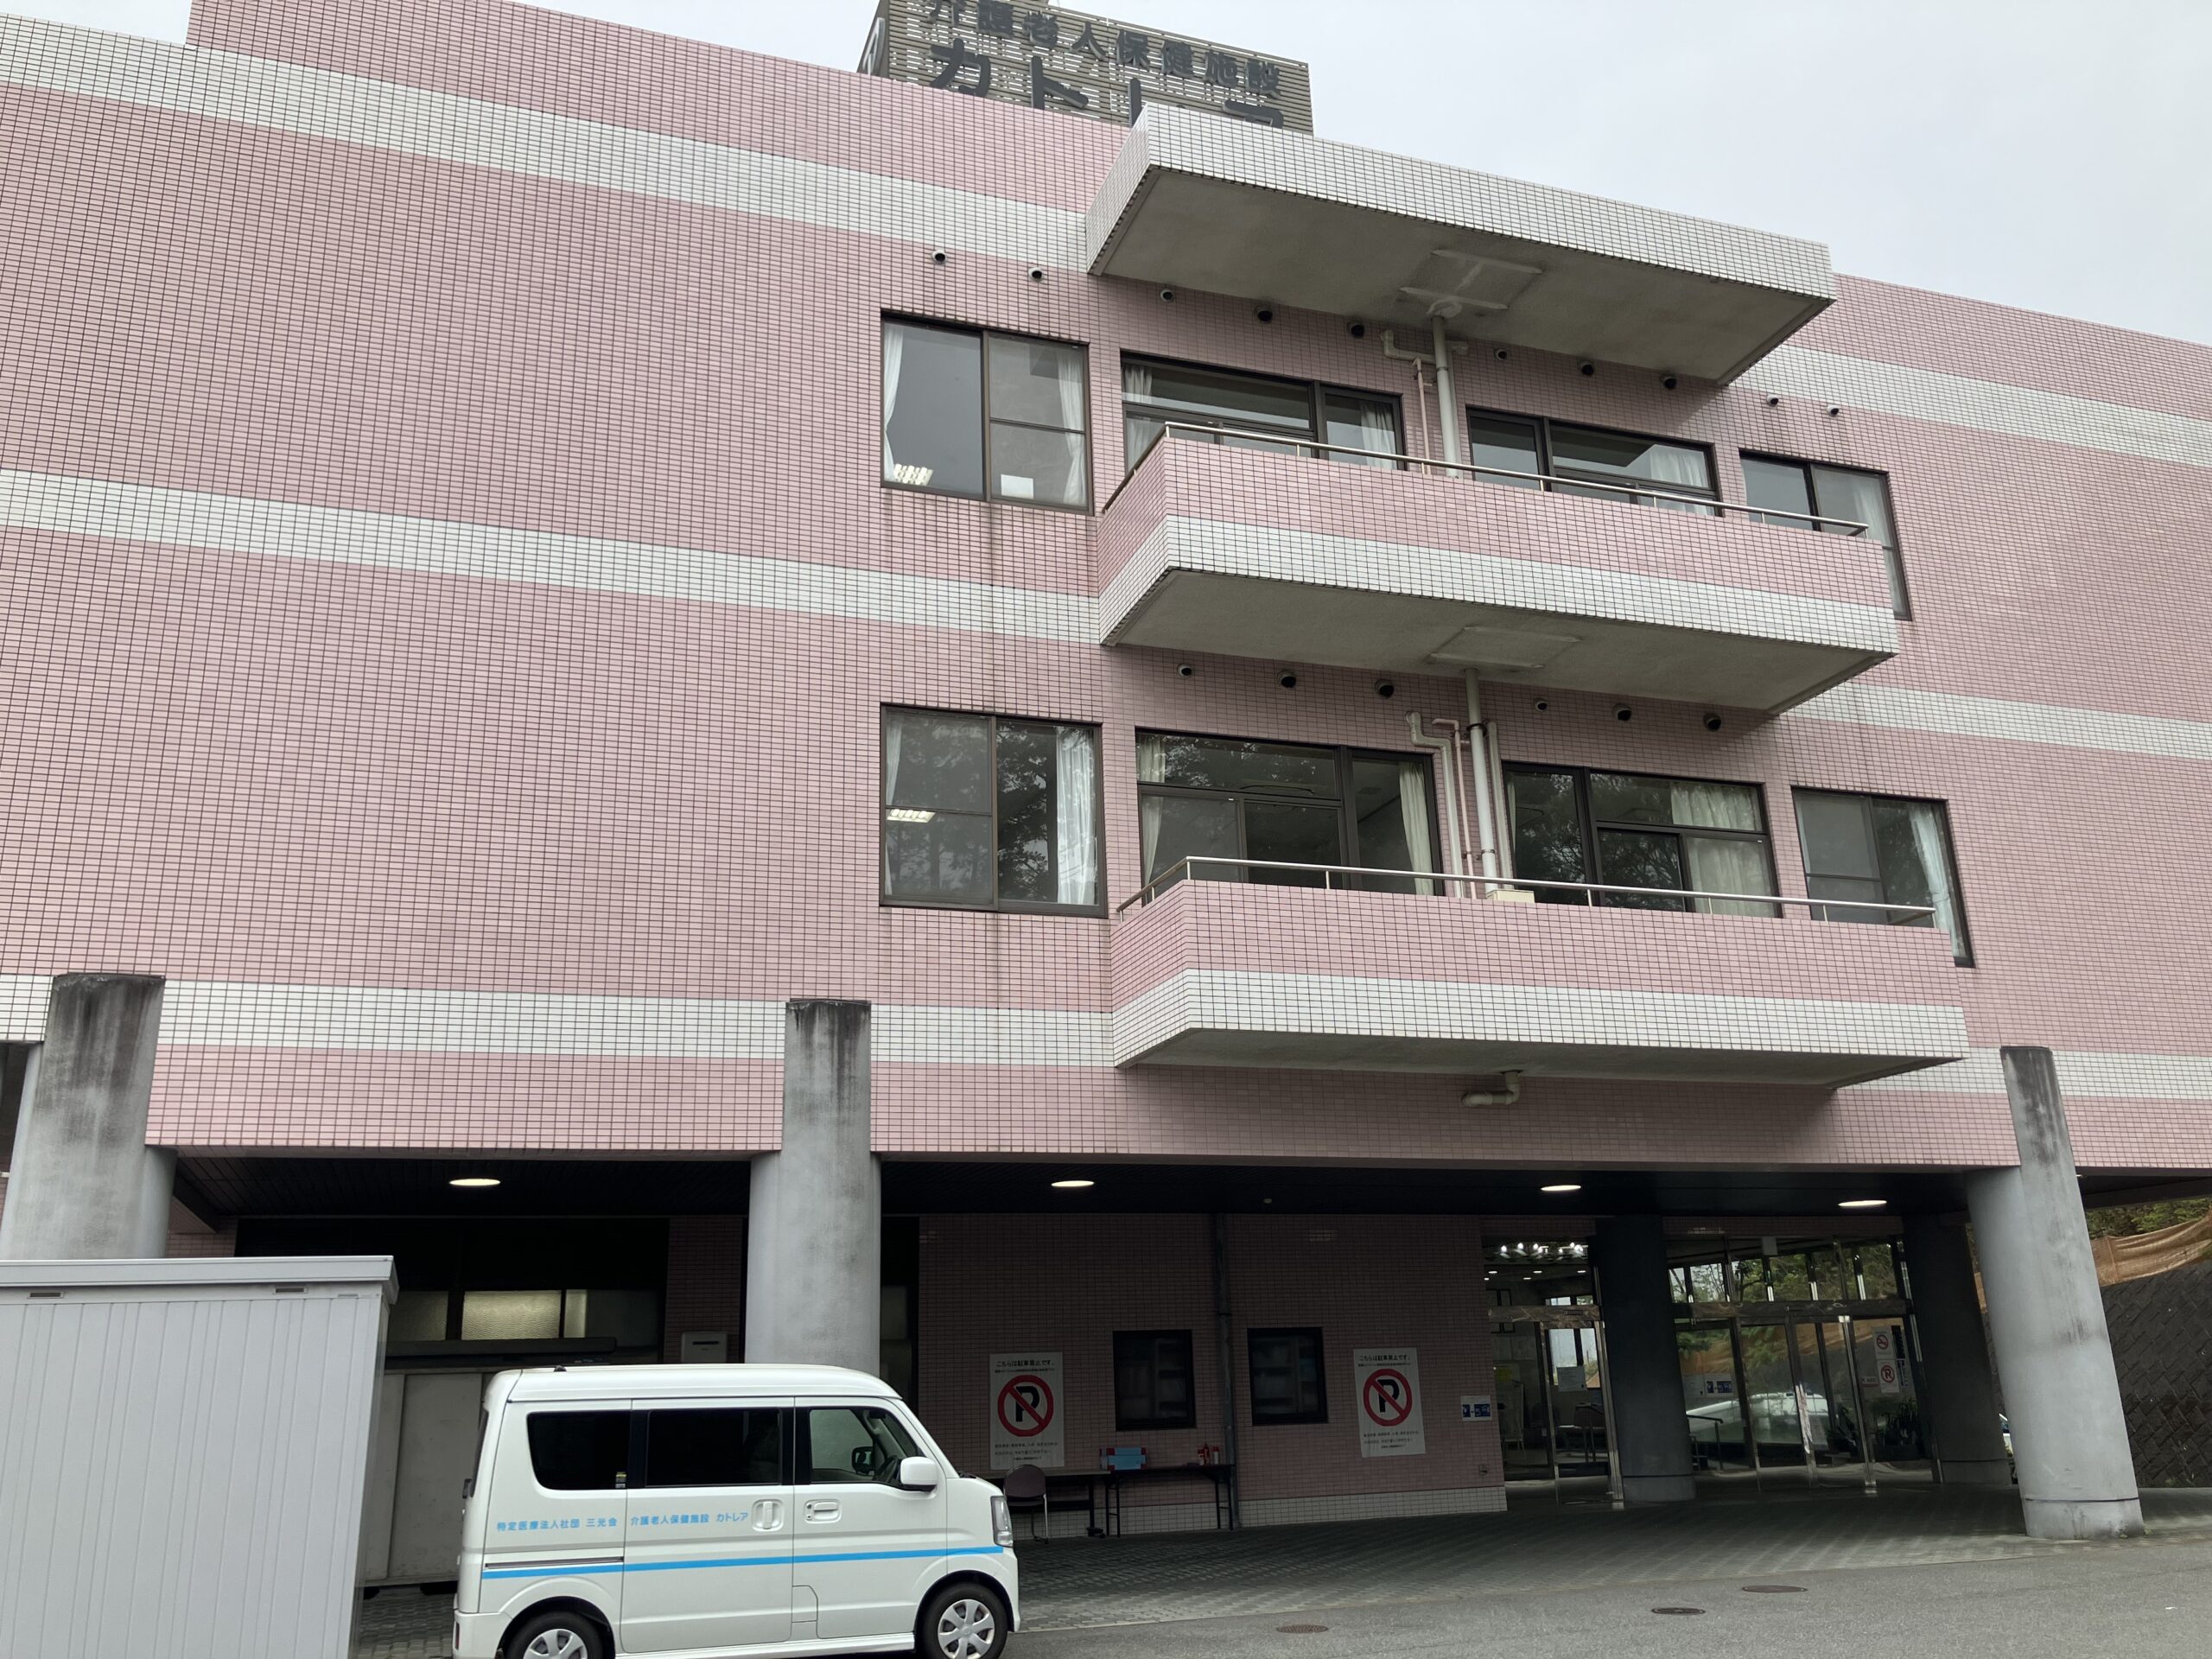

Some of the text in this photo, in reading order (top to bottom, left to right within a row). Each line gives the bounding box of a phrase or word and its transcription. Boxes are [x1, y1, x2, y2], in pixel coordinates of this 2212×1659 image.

[631, 1512, 710, 1527] 介護老人保健施設
[717, 1511, 748, 1522] カトレア
